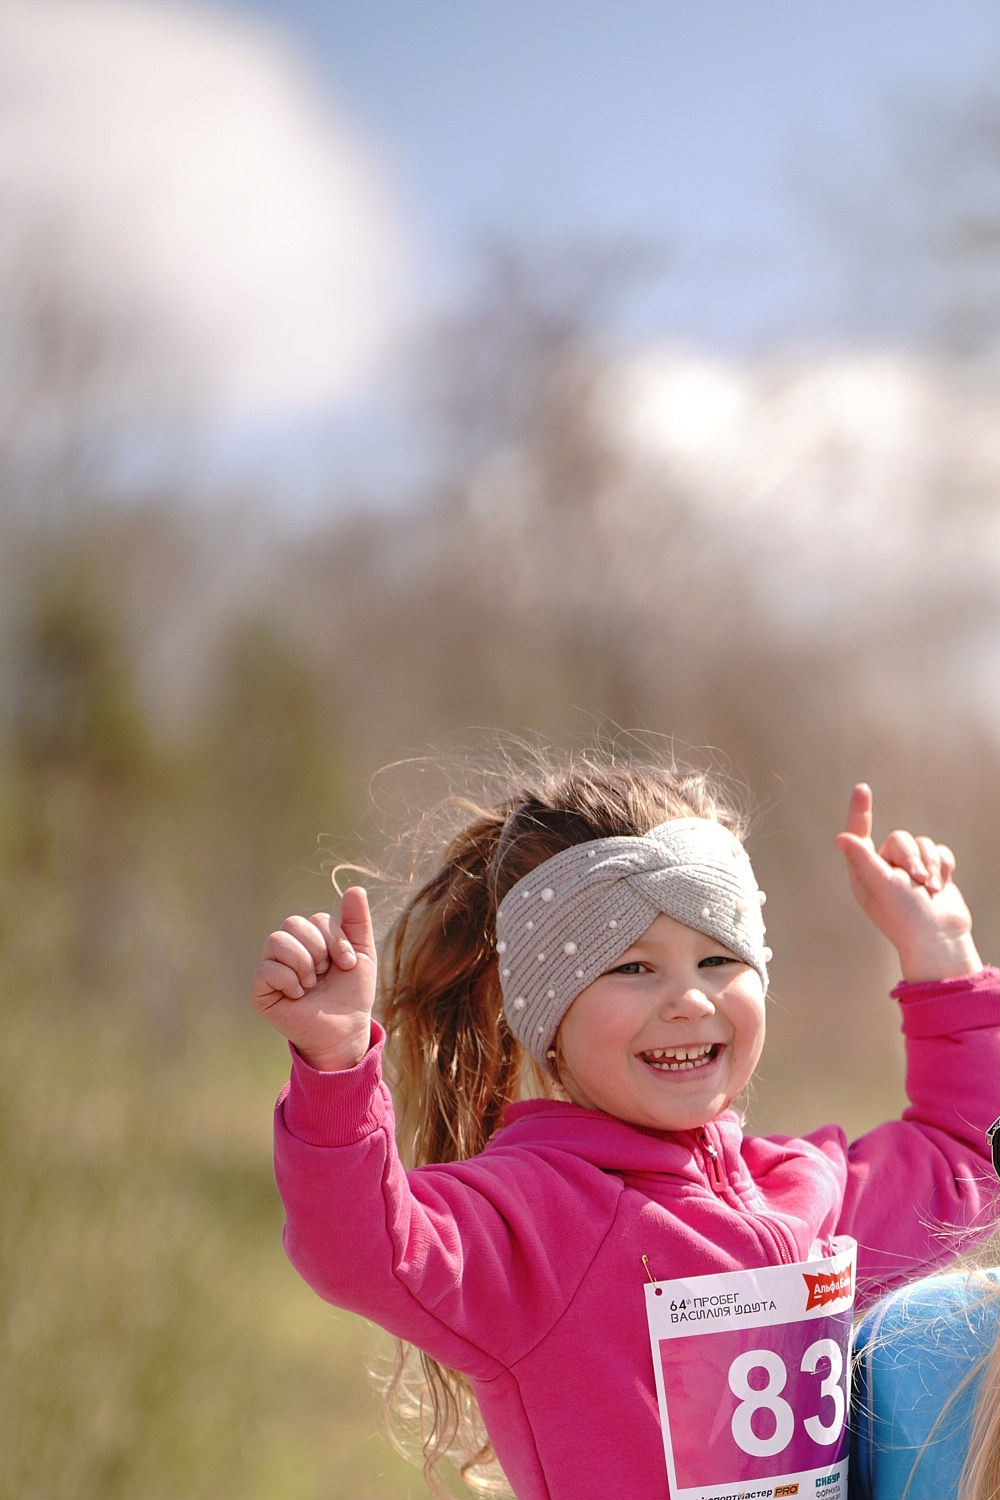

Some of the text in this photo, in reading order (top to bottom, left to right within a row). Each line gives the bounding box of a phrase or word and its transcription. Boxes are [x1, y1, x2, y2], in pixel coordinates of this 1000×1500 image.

[814, 1280, 839, 1297] Альфа
[693, 1292, 740, 1308] ПРОБЕГ
[670, 1306, 731, 1324] ВАСИЛИЯ
[728, 1338, 845, 1458] 83
[815, 1472, 841, 1488] СИБУР
[775, 1484, 799, 1498] PRO
